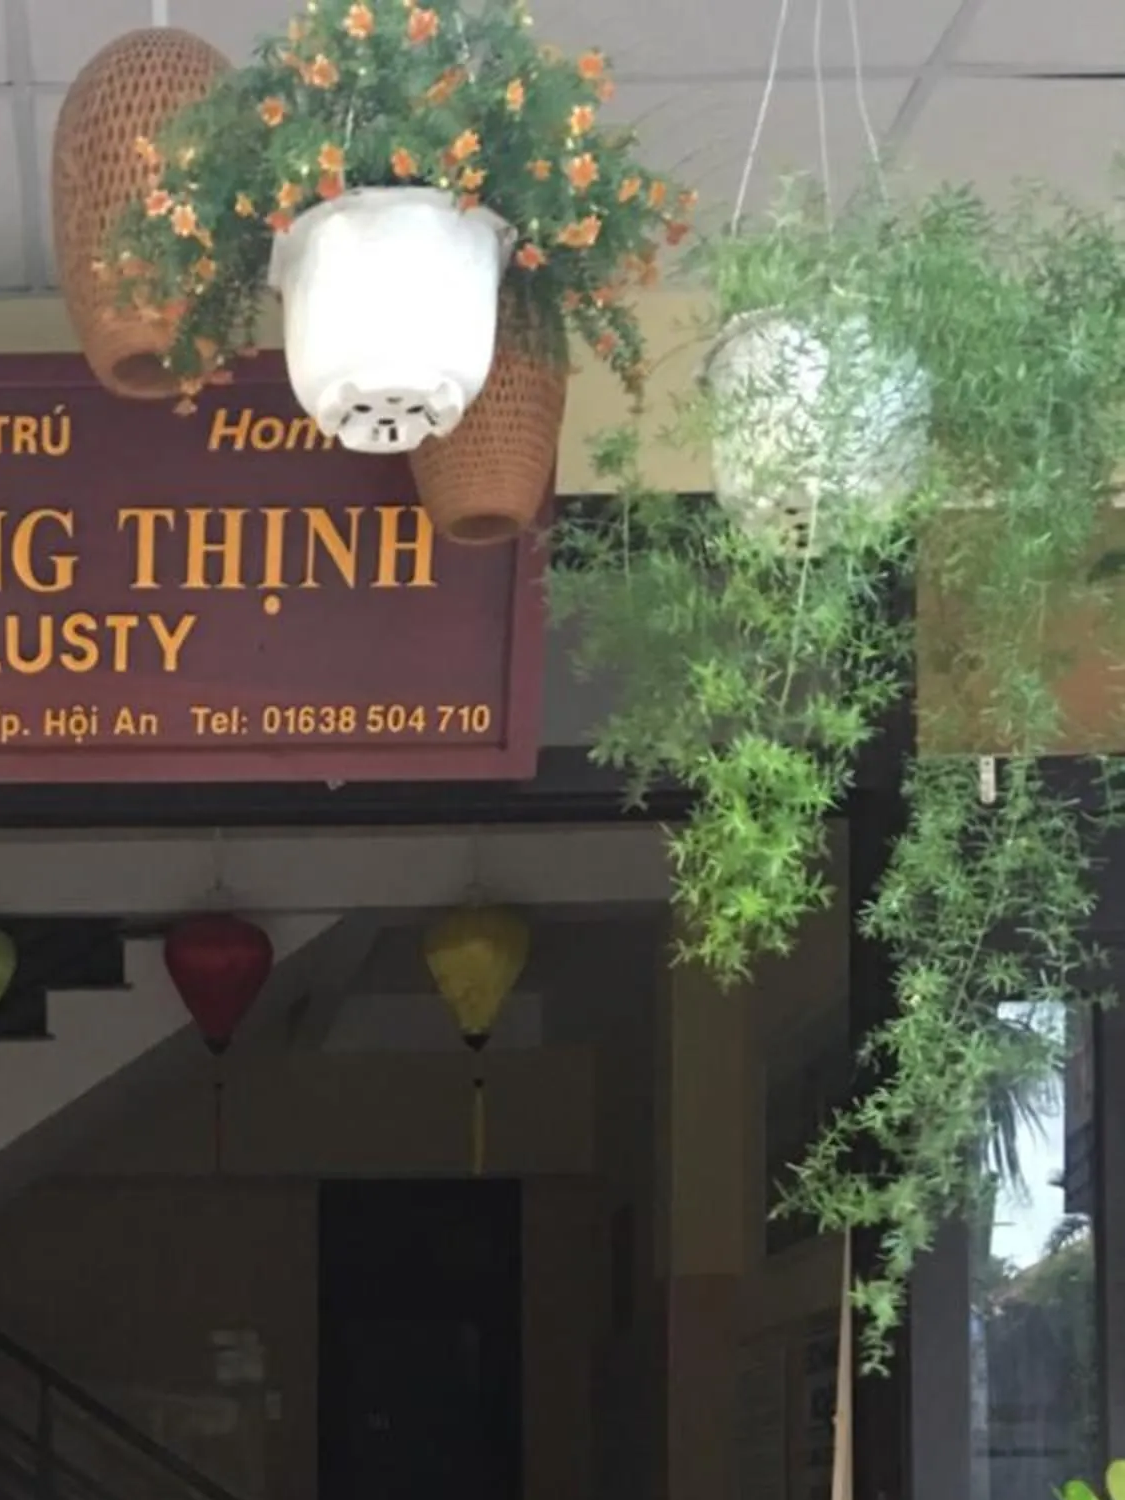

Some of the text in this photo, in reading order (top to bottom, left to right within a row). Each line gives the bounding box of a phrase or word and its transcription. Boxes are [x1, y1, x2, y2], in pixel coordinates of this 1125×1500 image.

[117, 504, 438, 616] THỊNH
[43, 704, 98, 745] Hội
[113, 705, 159, 737] An
[189, 705, 248, 736] Tel:
[261, 705, 358, 736] 01638
[365, 704, 428, 735] 504
[436, 703, 492, 734] 710
